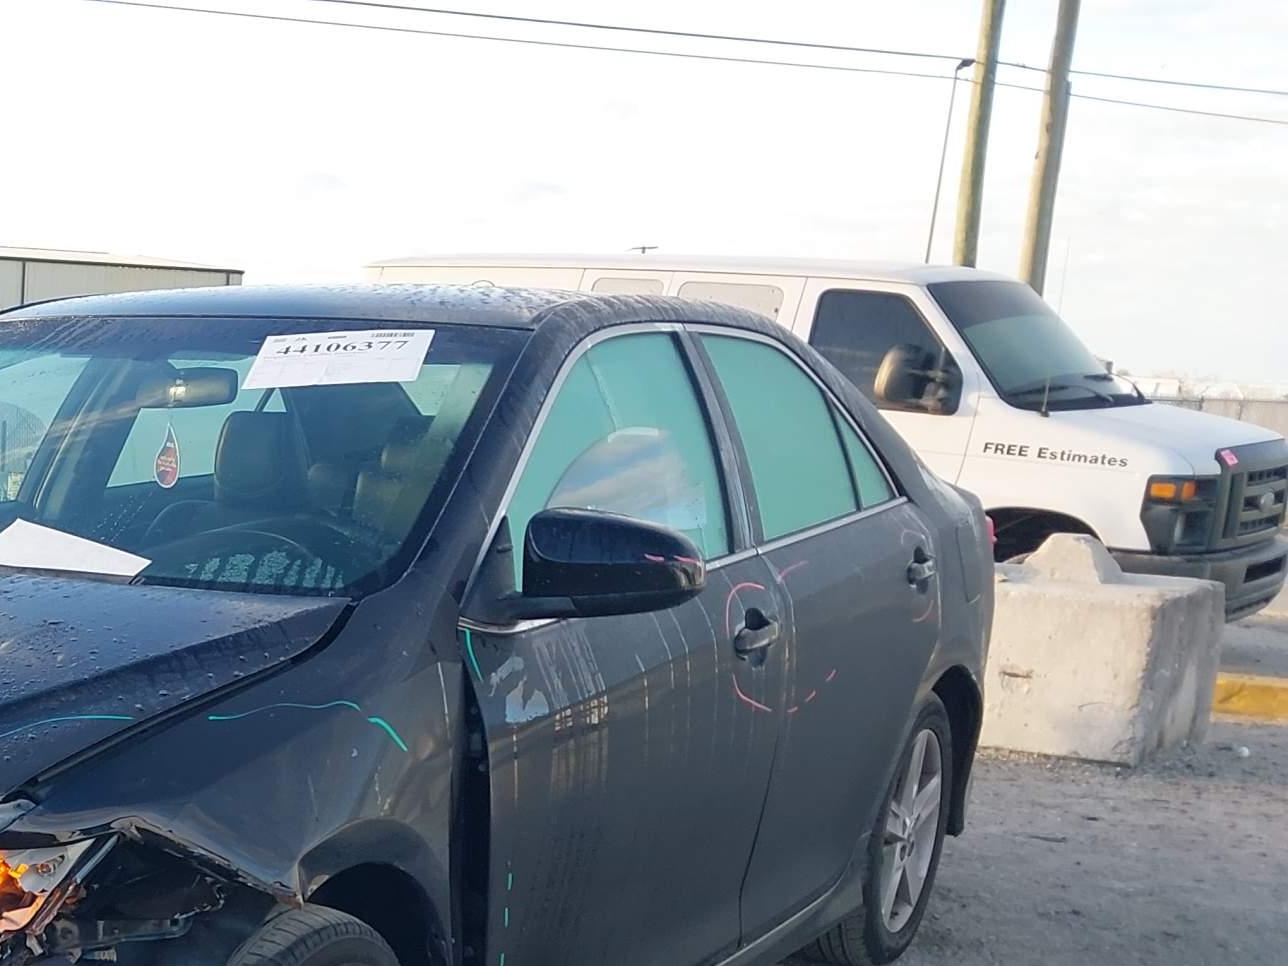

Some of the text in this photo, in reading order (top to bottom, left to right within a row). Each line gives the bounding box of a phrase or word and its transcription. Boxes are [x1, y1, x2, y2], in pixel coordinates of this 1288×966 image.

[276, 340, 409, 355] 44106377
[983, 442, 1128, 467] FREE Estimates
